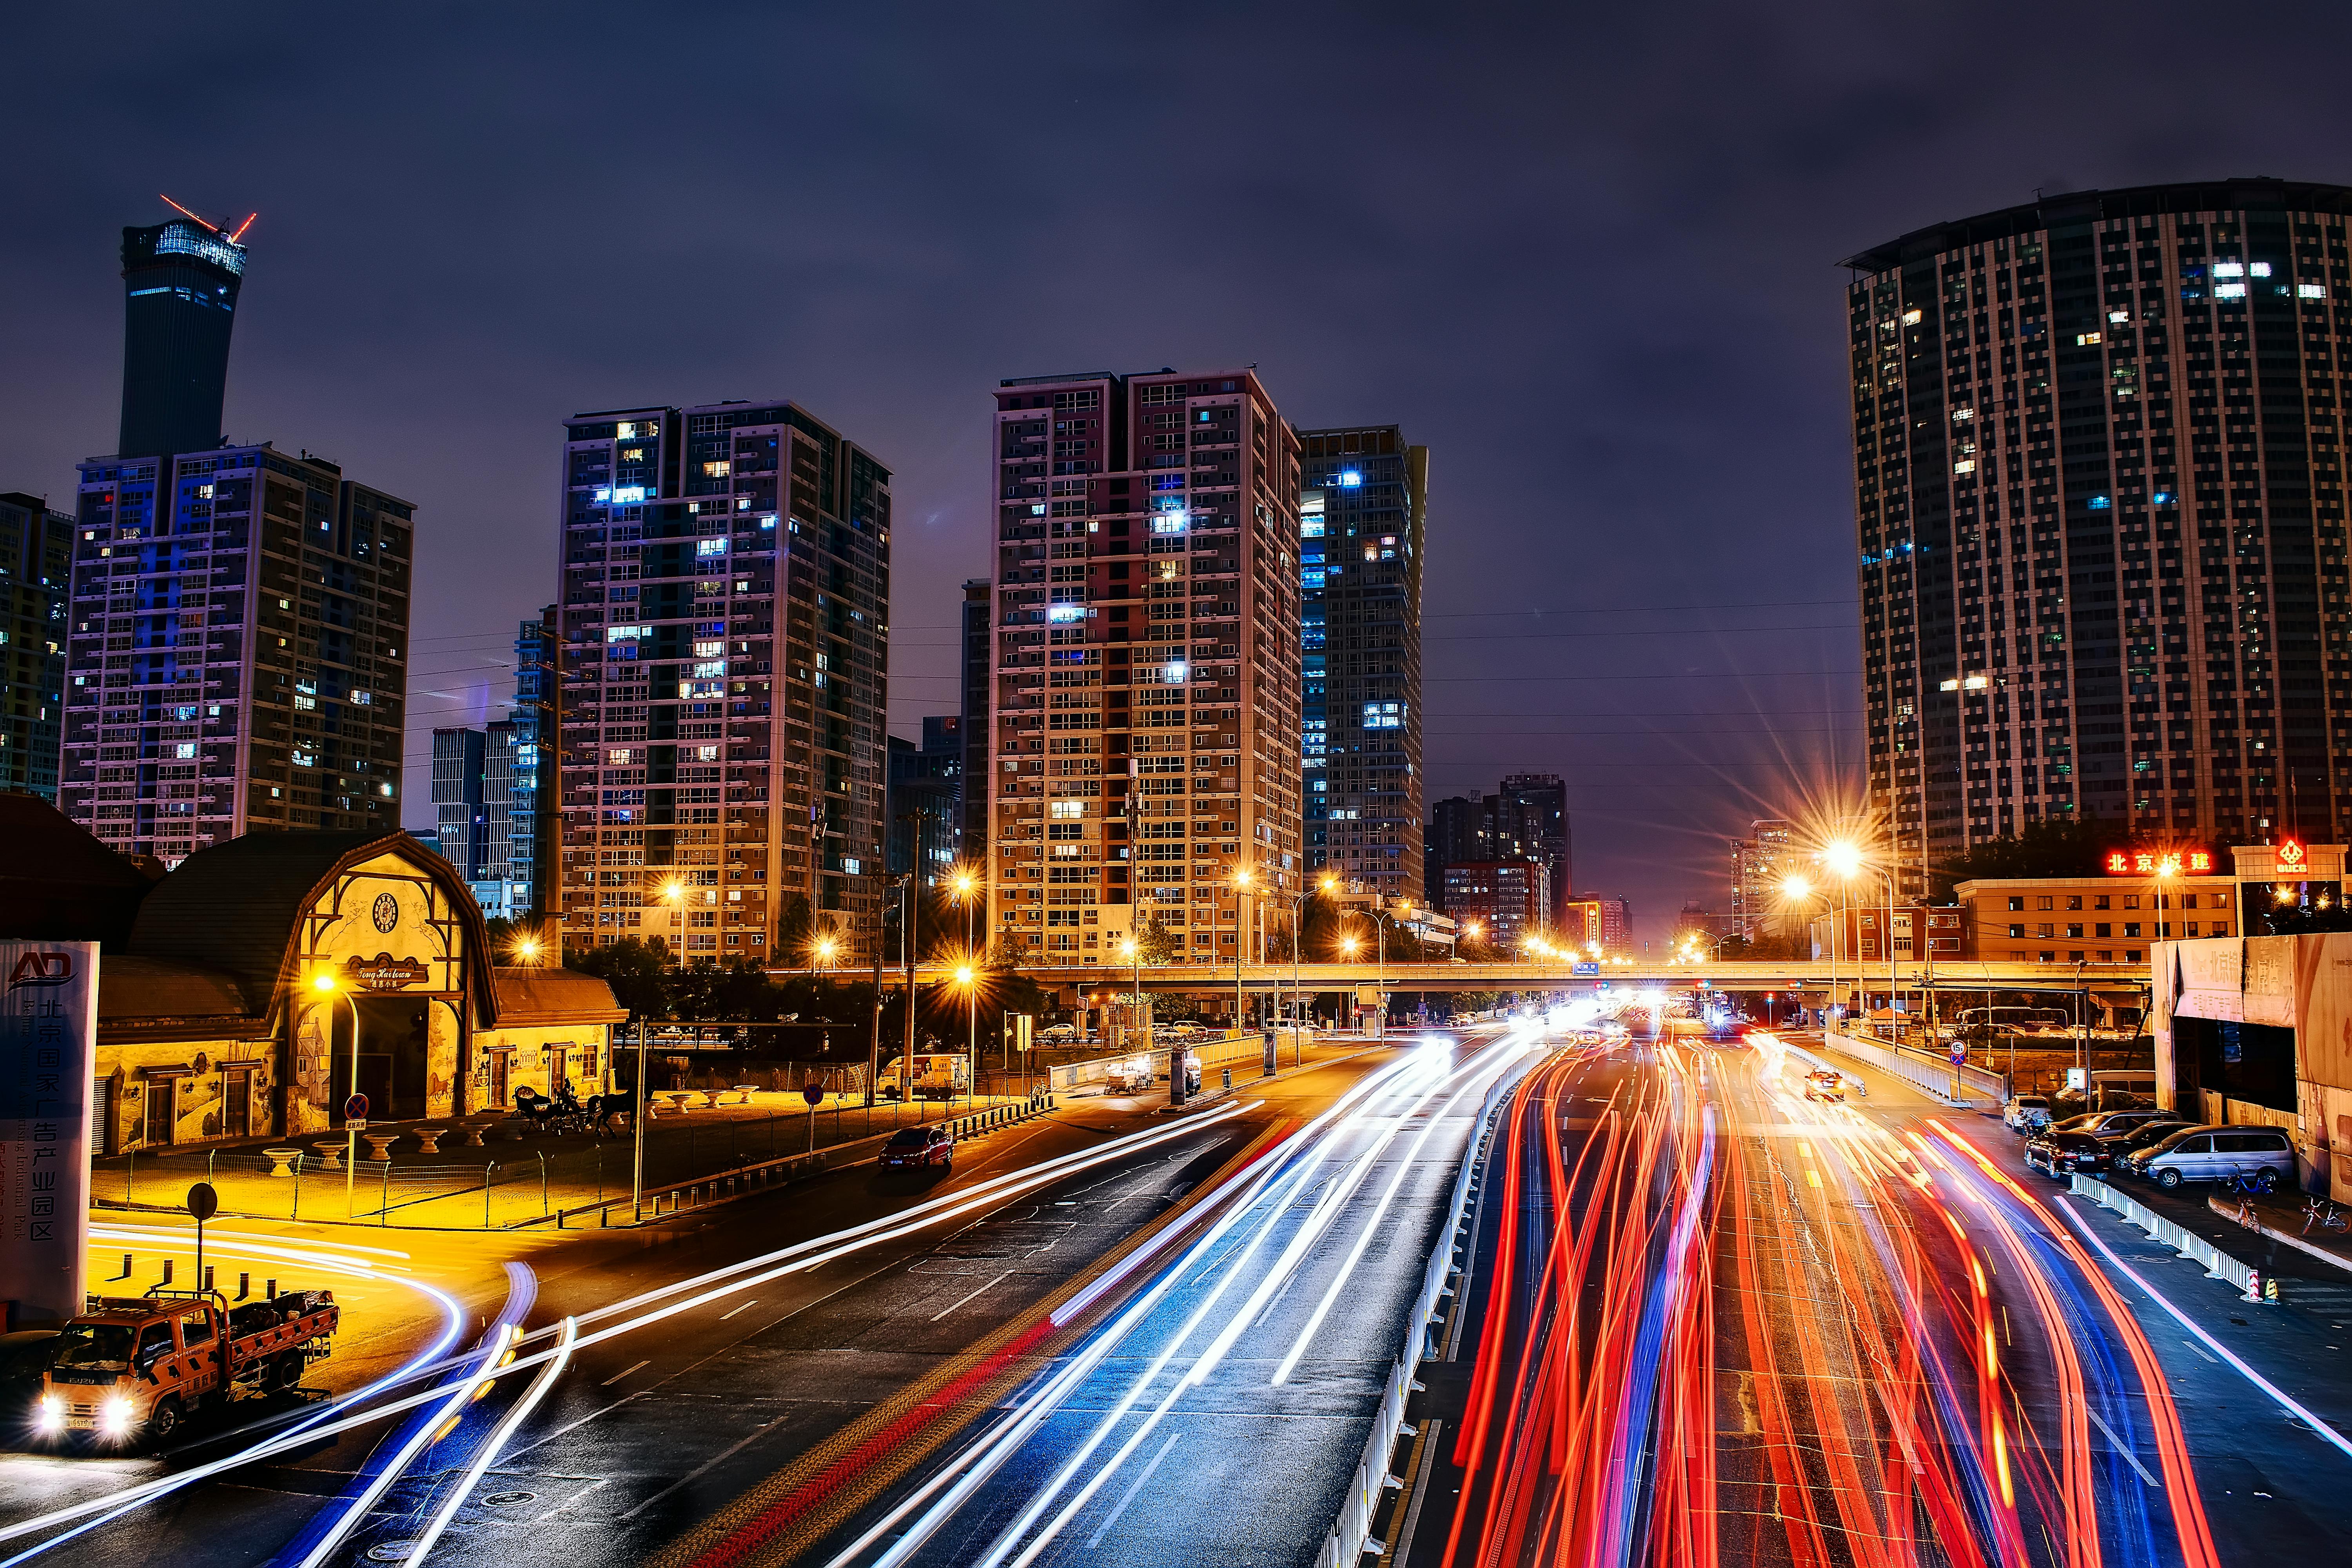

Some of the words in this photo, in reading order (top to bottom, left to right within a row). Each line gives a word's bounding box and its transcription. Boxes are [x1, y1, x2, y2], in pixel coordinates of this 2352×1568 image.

[2109, 853, 2210, 872] 北京城建
[20, 1000, 35, 1037] Beijing
[19, 1041, 33, 1087] National
[15, 1090, 31, 1152] Advertising
[30, 999, 63, 1242] 北京国家广告产业园区
[15, 1156, 28, 1207] Industrial
[14, 1215, 26, 1240] Park
